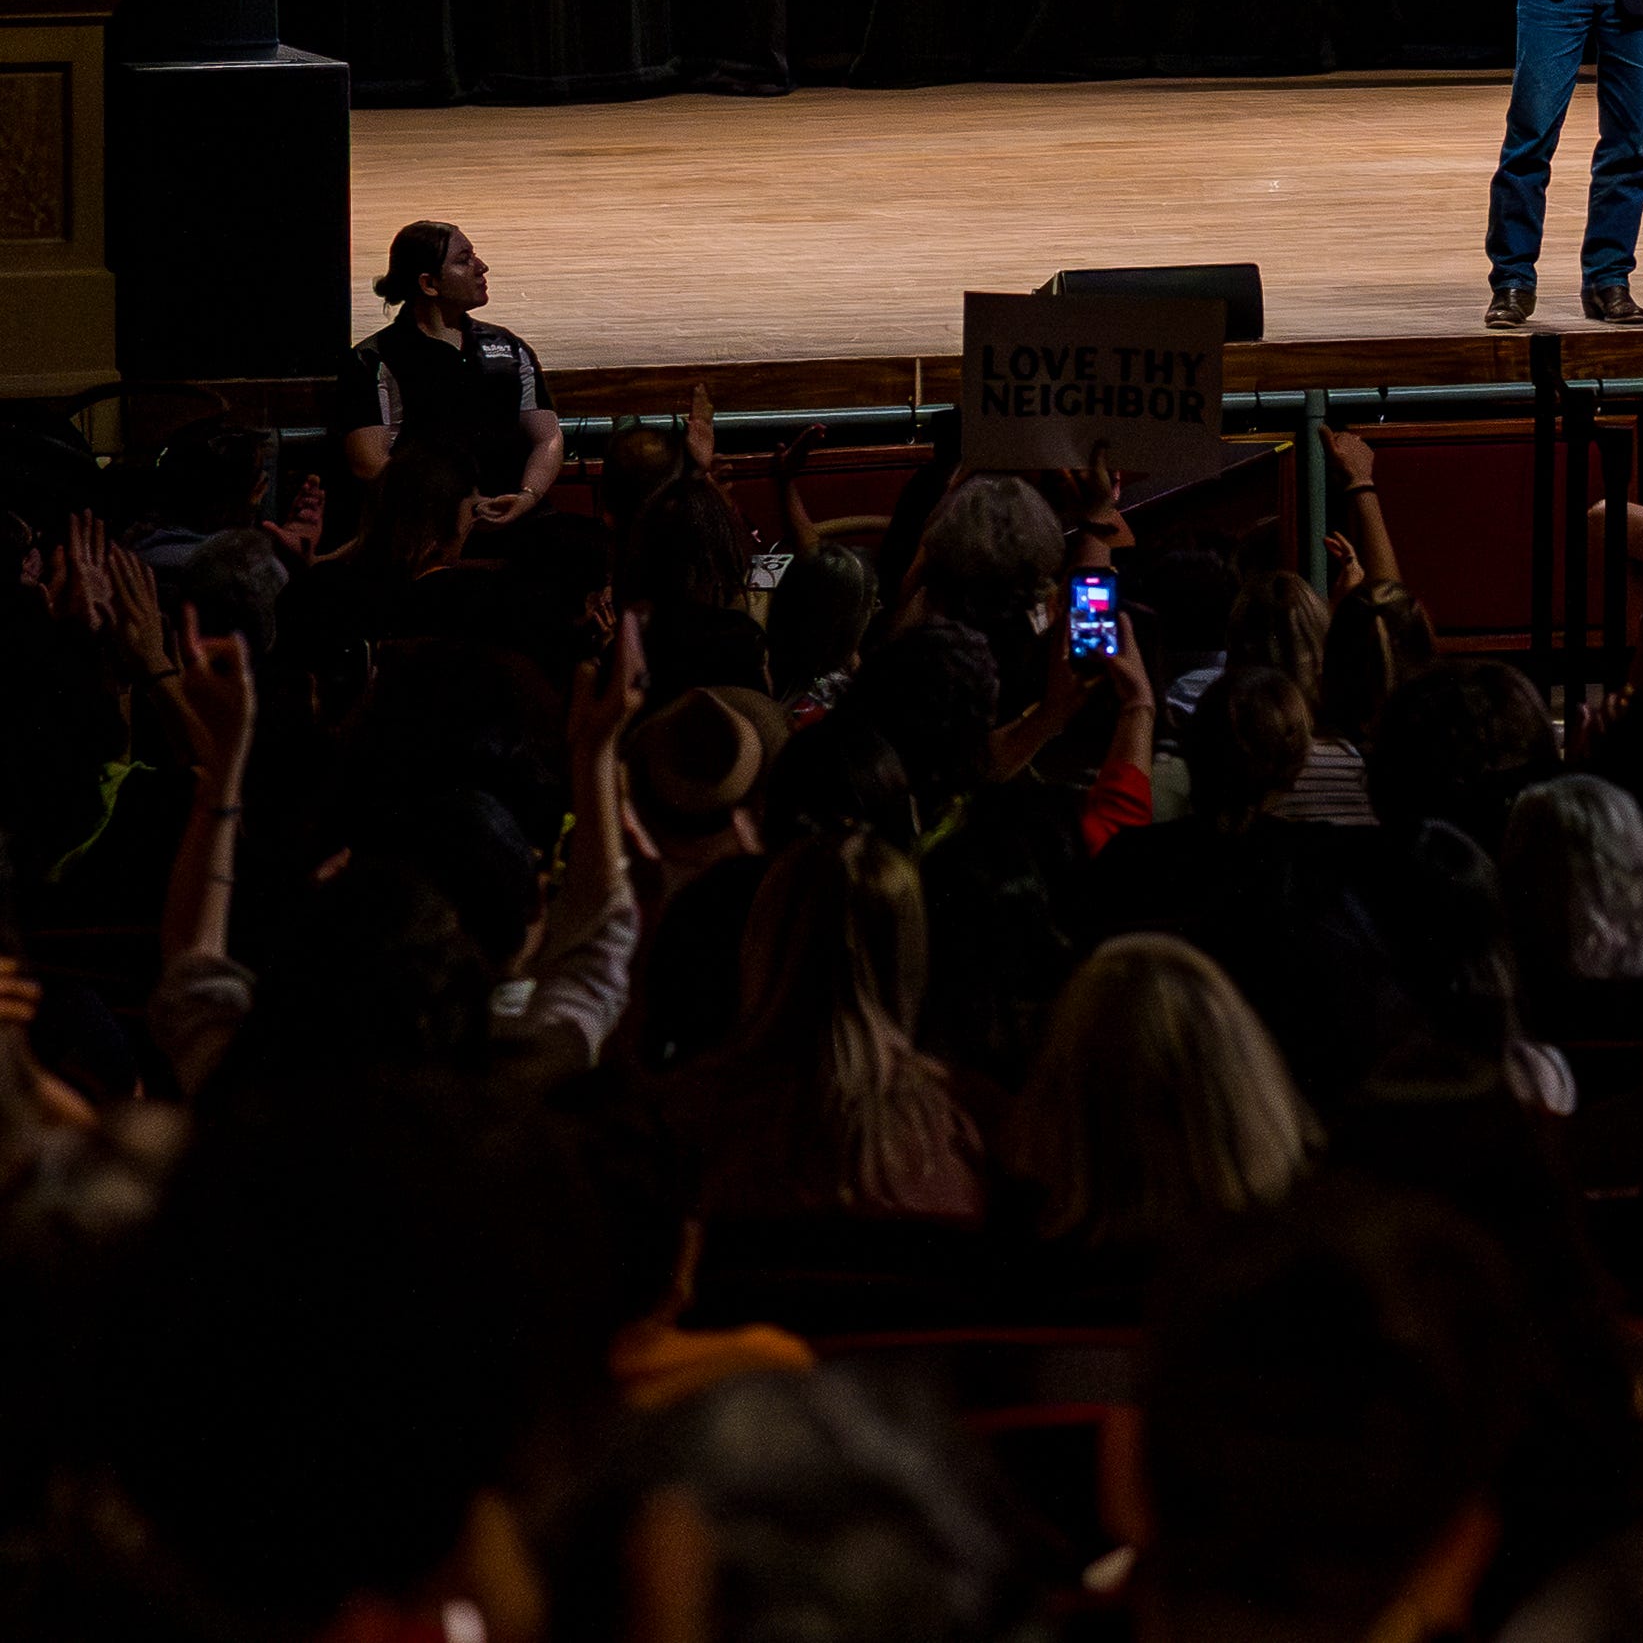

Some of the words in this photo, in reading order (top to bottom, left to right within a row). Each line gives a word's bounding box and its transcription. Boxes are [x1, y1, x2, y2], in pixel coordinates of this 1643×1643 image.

[982, 345, 1098, 381] LOVE
[1113, 347, 1207, 386] THY
[981, 382, 1206, 424] NEIGHBOR
